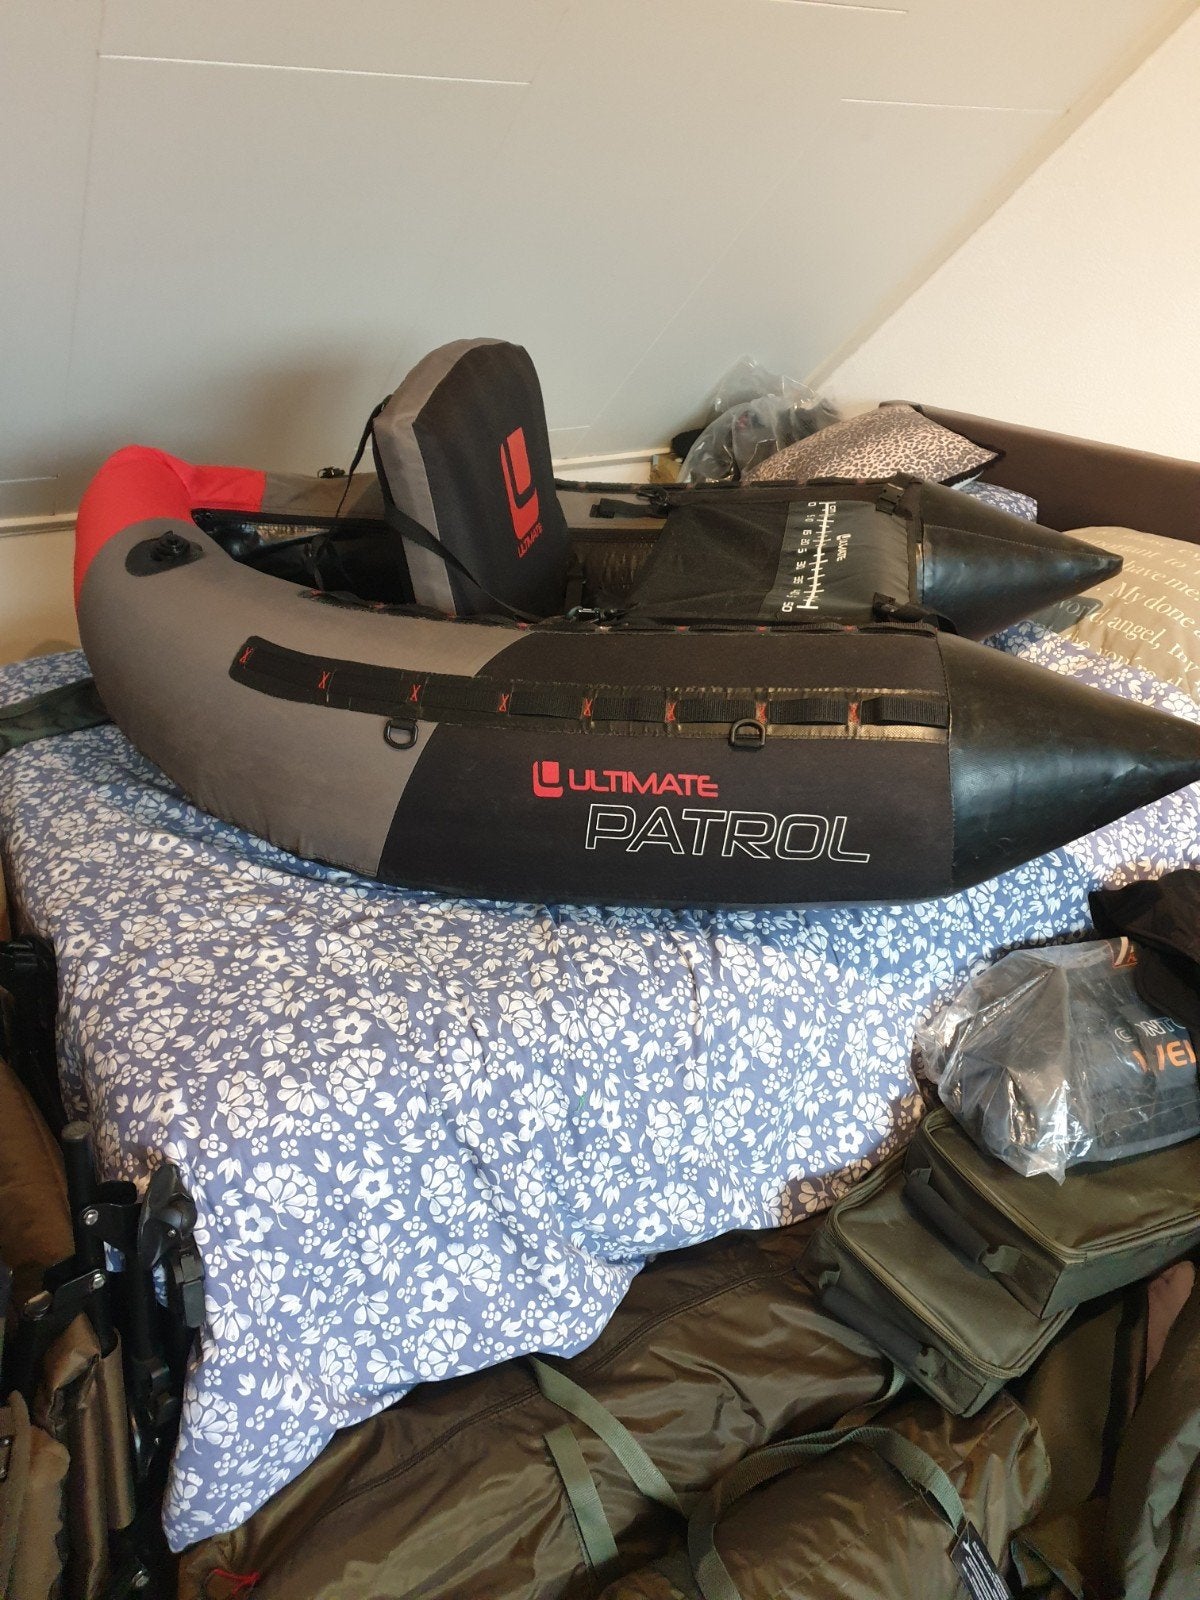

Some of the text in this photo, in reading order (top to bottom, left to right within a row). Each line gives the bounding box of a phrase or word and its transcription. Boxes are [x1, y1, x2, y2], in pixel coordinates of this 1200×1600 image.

[781, 601, 794, 613] 50
[1108, 581, 1195, 628] My done
[1107, 616, 1167, 650] angel,
[568, 768, 719, 798] ULTIMATE
[585, 803, 871, 863] PATROL
